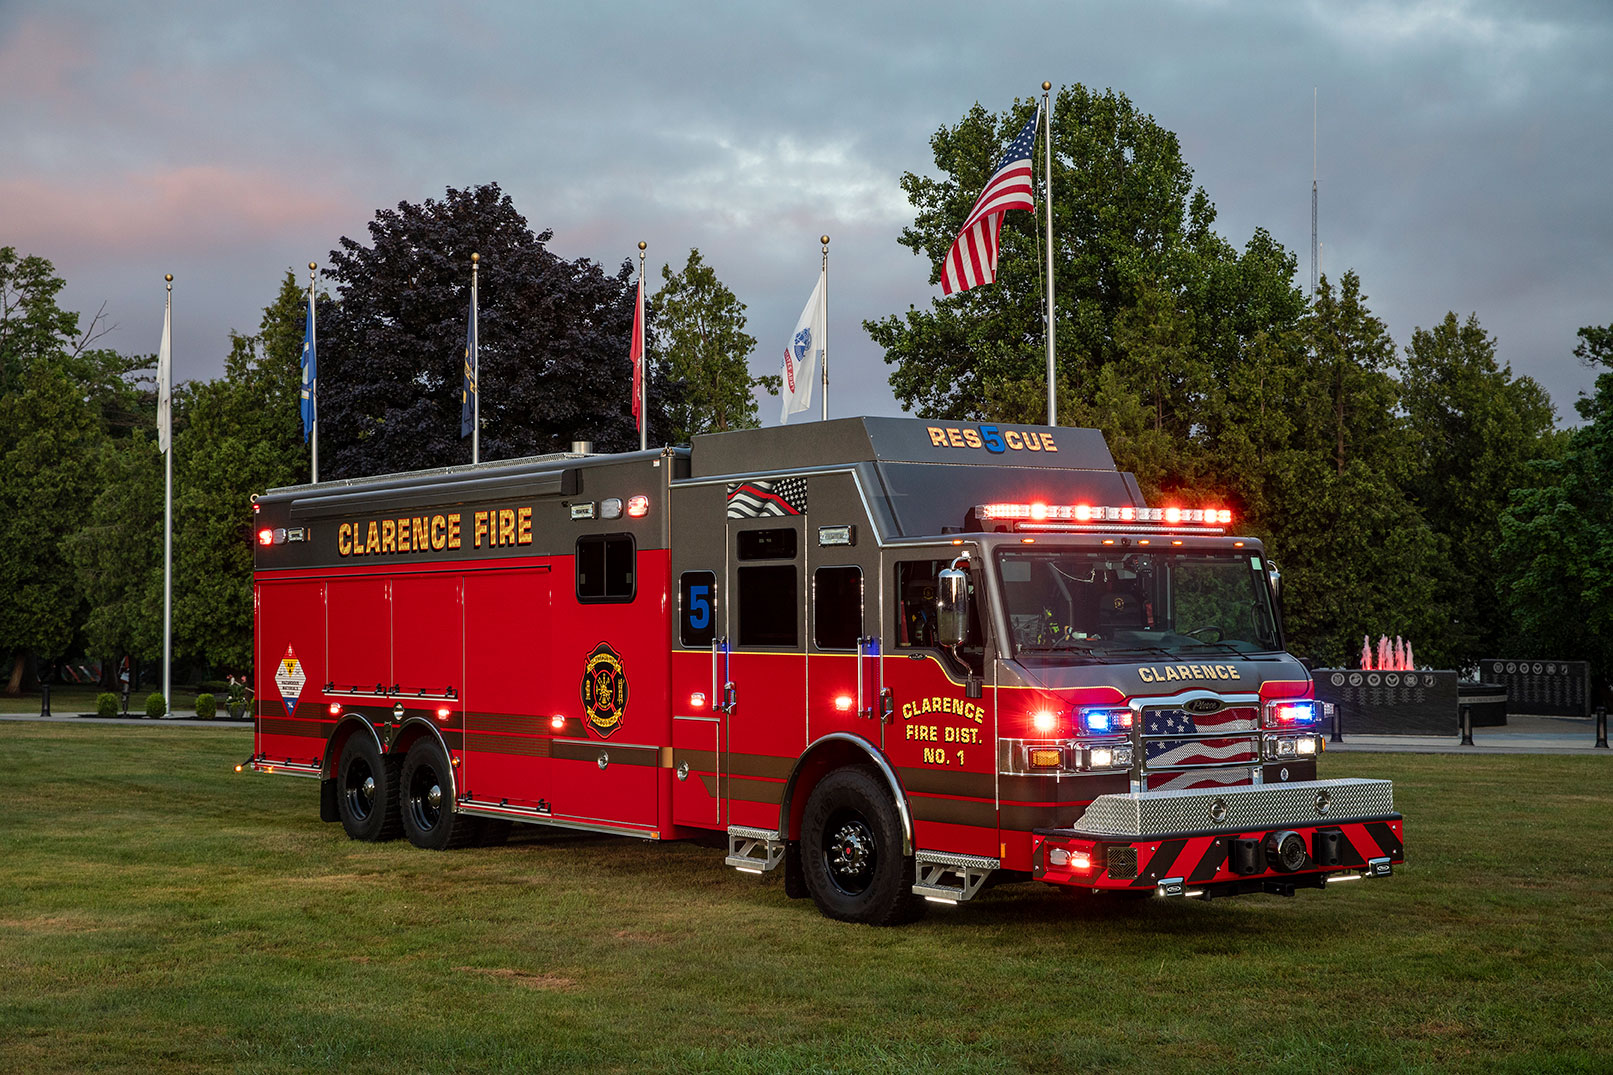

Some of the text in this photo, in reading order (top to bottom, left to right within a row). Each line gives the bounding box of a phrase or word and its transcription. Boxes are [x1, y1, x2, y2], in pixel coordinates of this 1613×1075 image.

[926, 425, 1059, 454] RES5CUE
[338, 507, 534, 556] CLARENCE FIRE
[689, 585, 710, 629] 5
[1138, 665, 1241, 683] CLARENCE
[902, 697, 985, 724] CLARENCE
[1192, 701, 1218, 711] Pierce
[906, 725, 983, 744] FIRE DIST.
[924, 748, 965, 766] NO. 1
